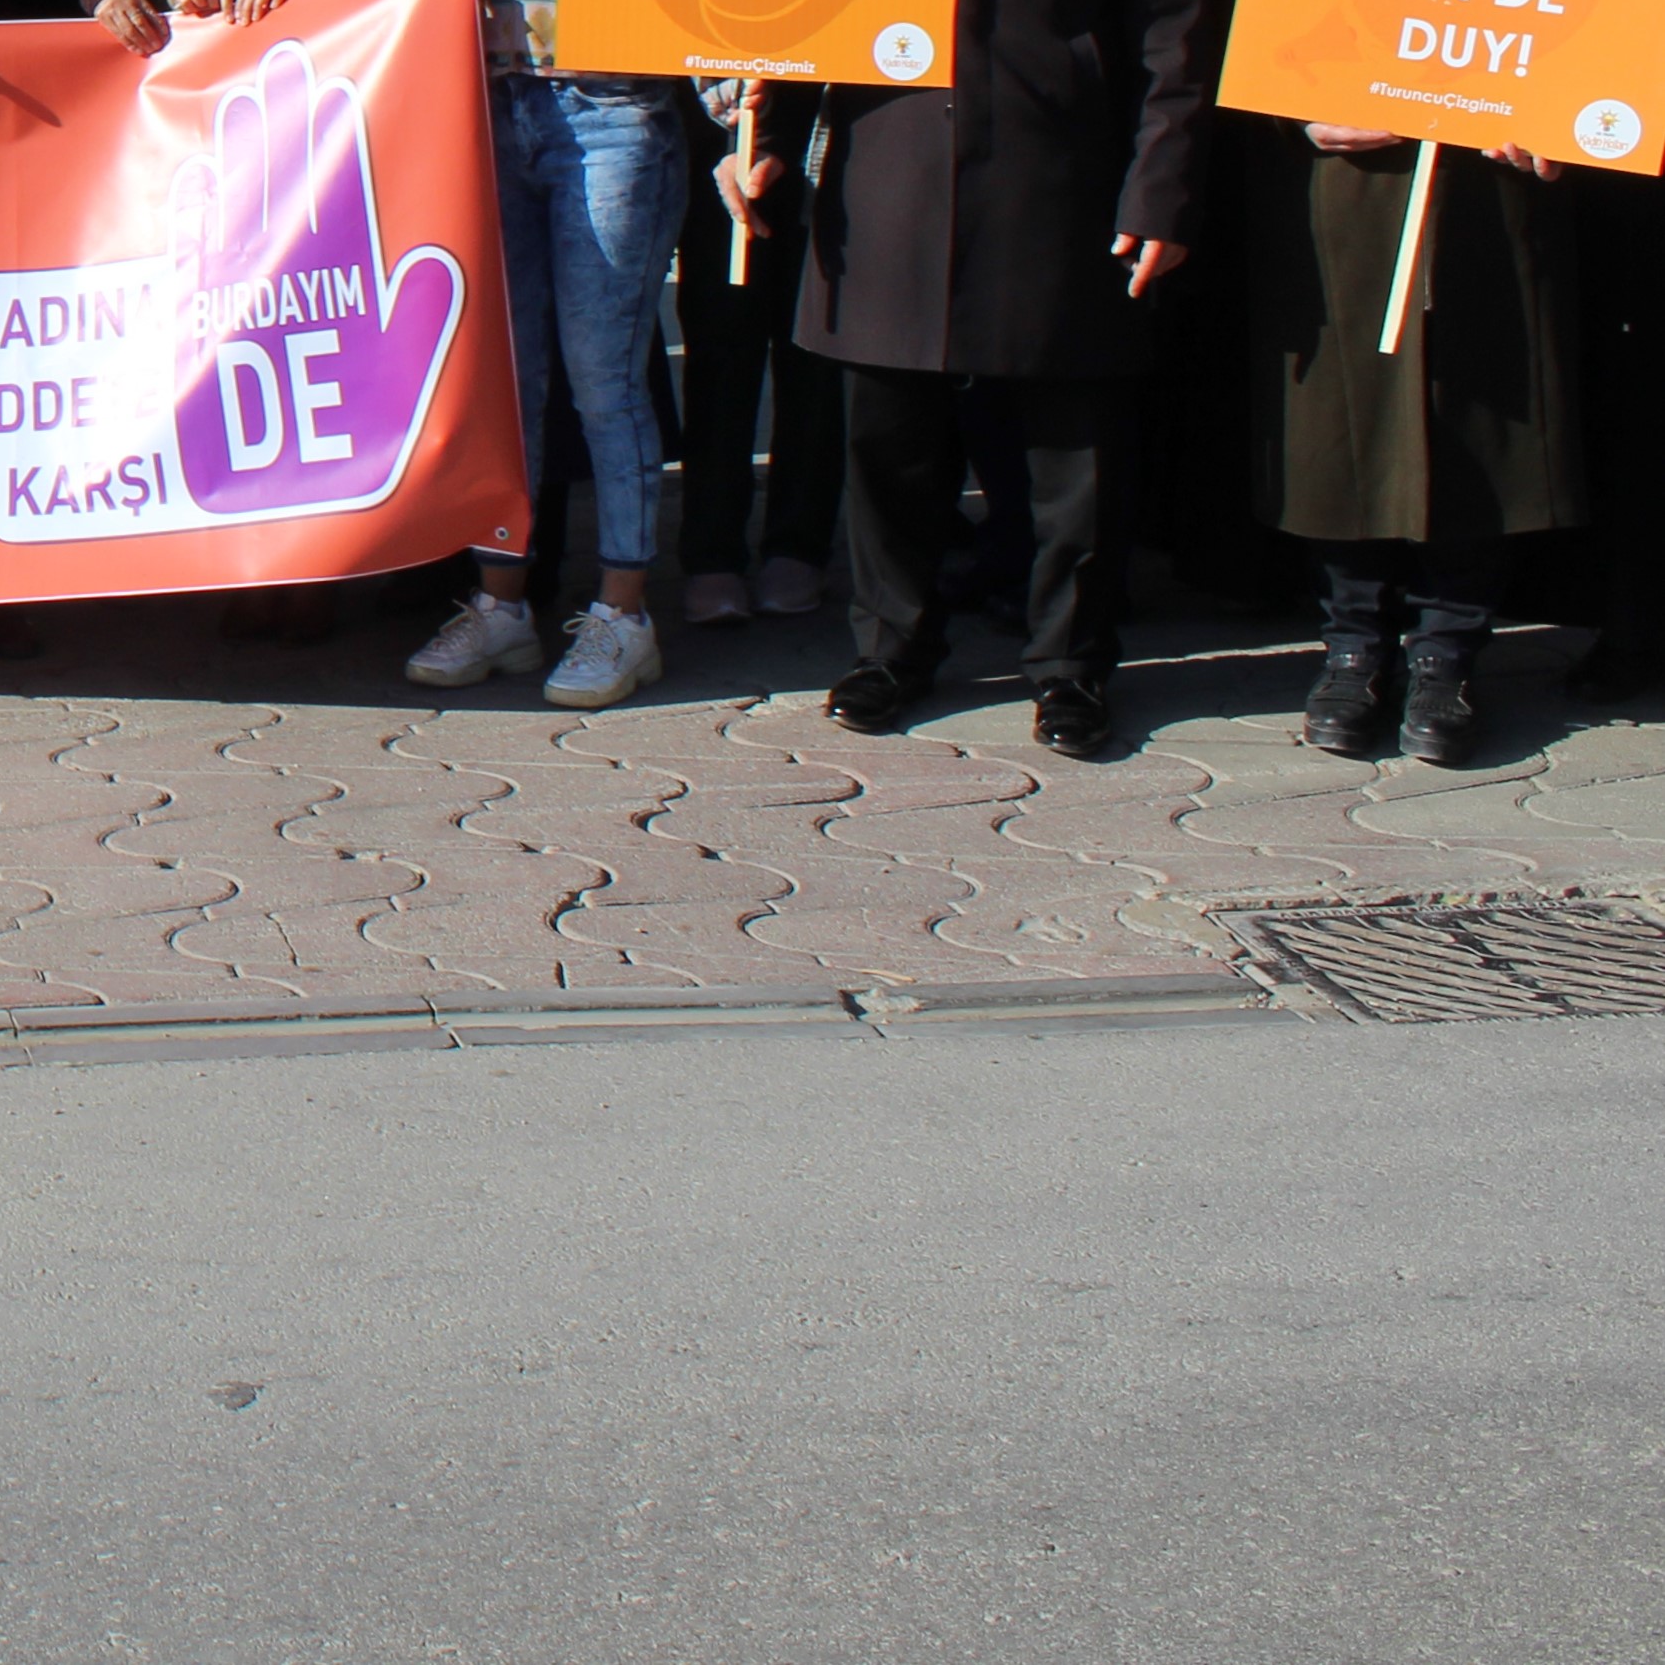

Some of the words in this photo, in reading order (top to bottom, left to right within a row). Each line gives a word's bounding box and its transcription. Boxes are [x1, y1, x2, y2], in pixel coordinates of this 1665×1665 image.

[685, 55, 816, 75] #TuruncuÇizgimiz
[1397, 17, 1533, 78] DUY!
[1369, 81, 1513, 116] #TuruncuÇizgimiz
[192, 264, 367, 339] BURDAYIM
[217, 329, 353, 472] DE
[8, 452, 168, 517] KARŞI
